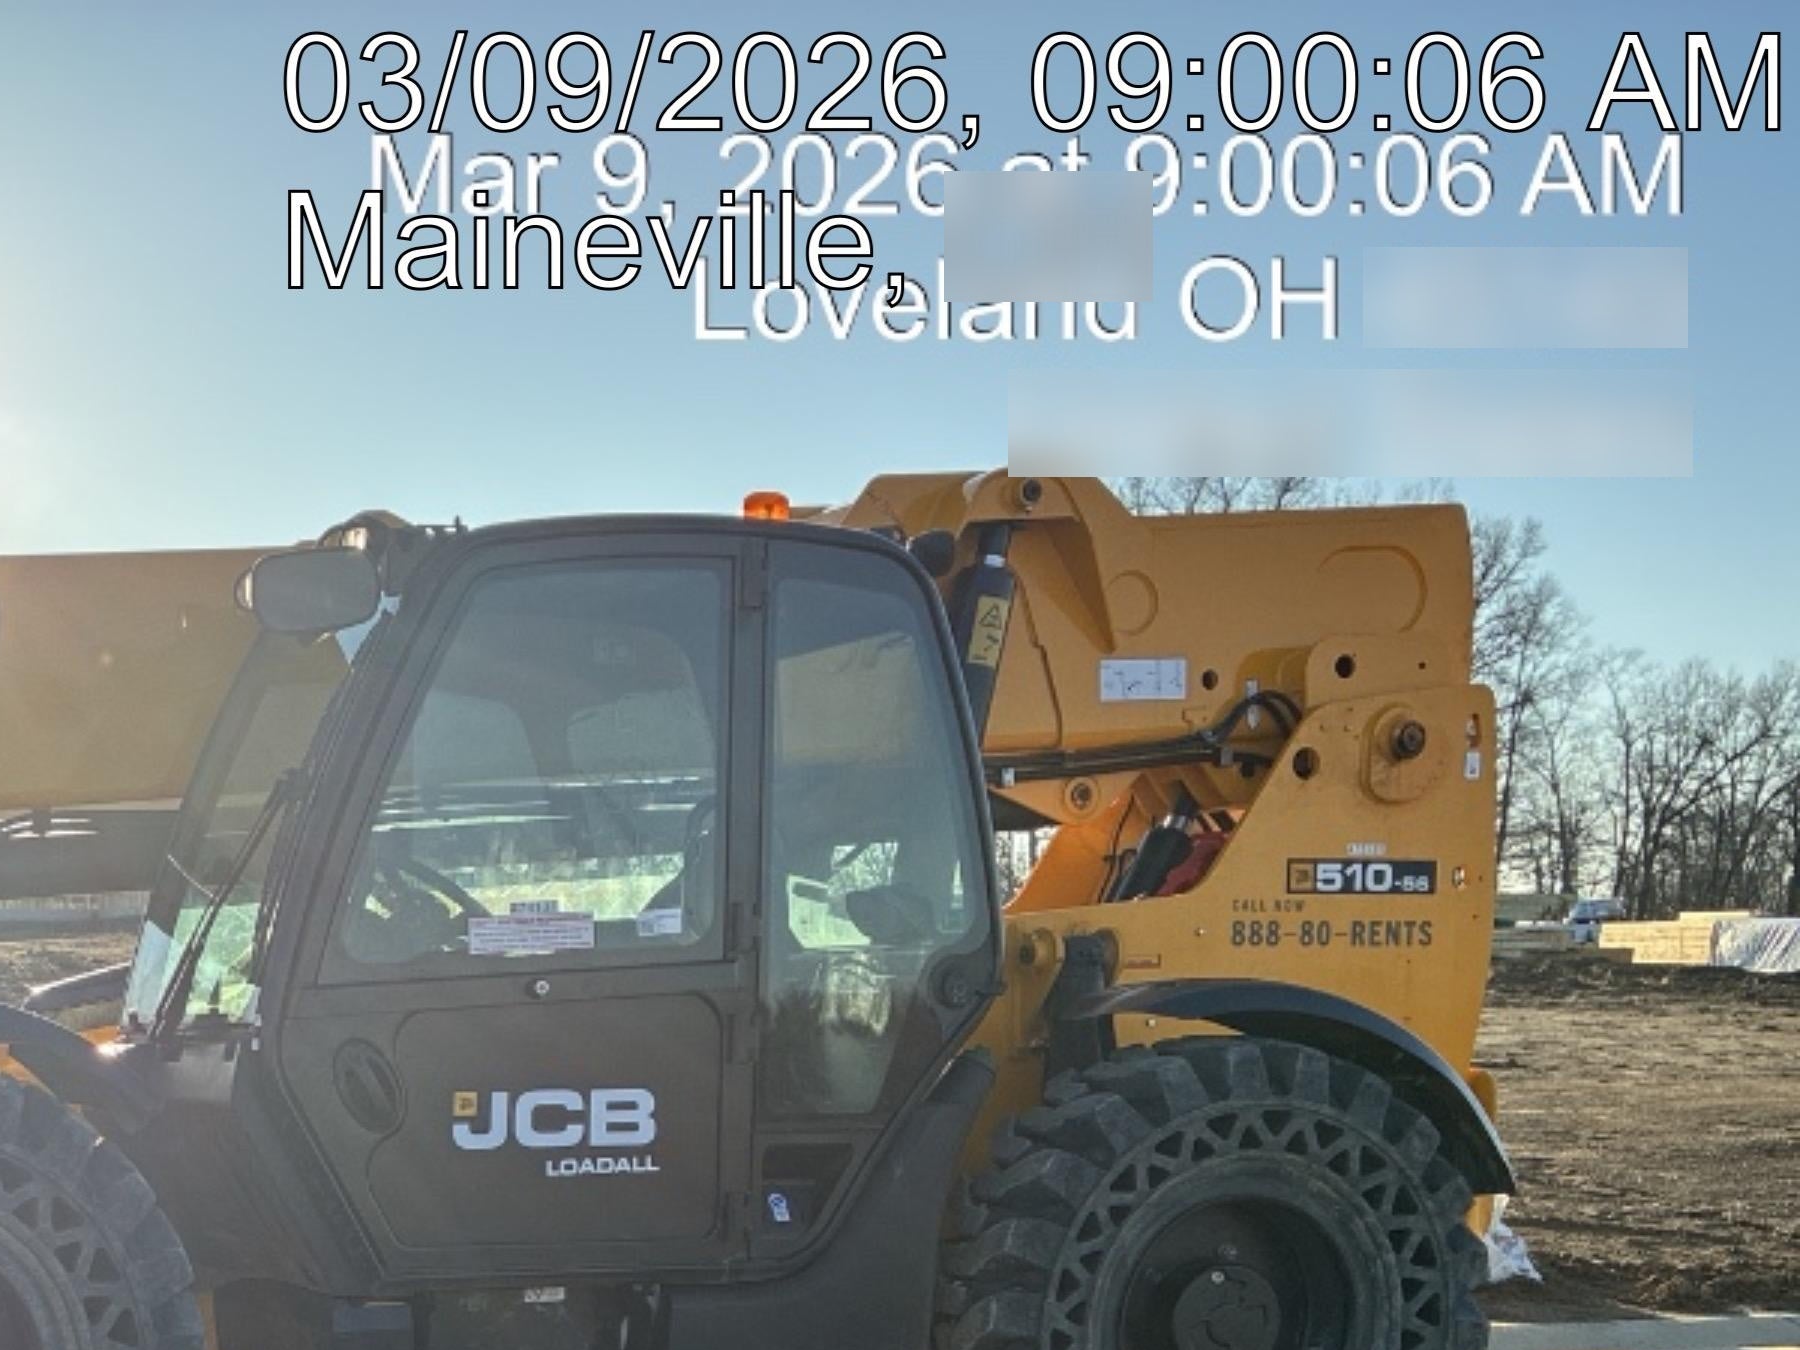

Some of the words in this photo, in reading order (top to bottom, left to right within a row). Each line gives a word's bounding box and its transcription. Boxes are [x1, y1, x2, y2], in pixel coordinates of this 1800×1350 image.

[1233, 900, 1267, 912] CALL
[1231, 920, 1433, 946] 888-80-RENTS
[452, 1088, 657, 1150] JCB
[545, 1155, 661, 1177] LOADALL
